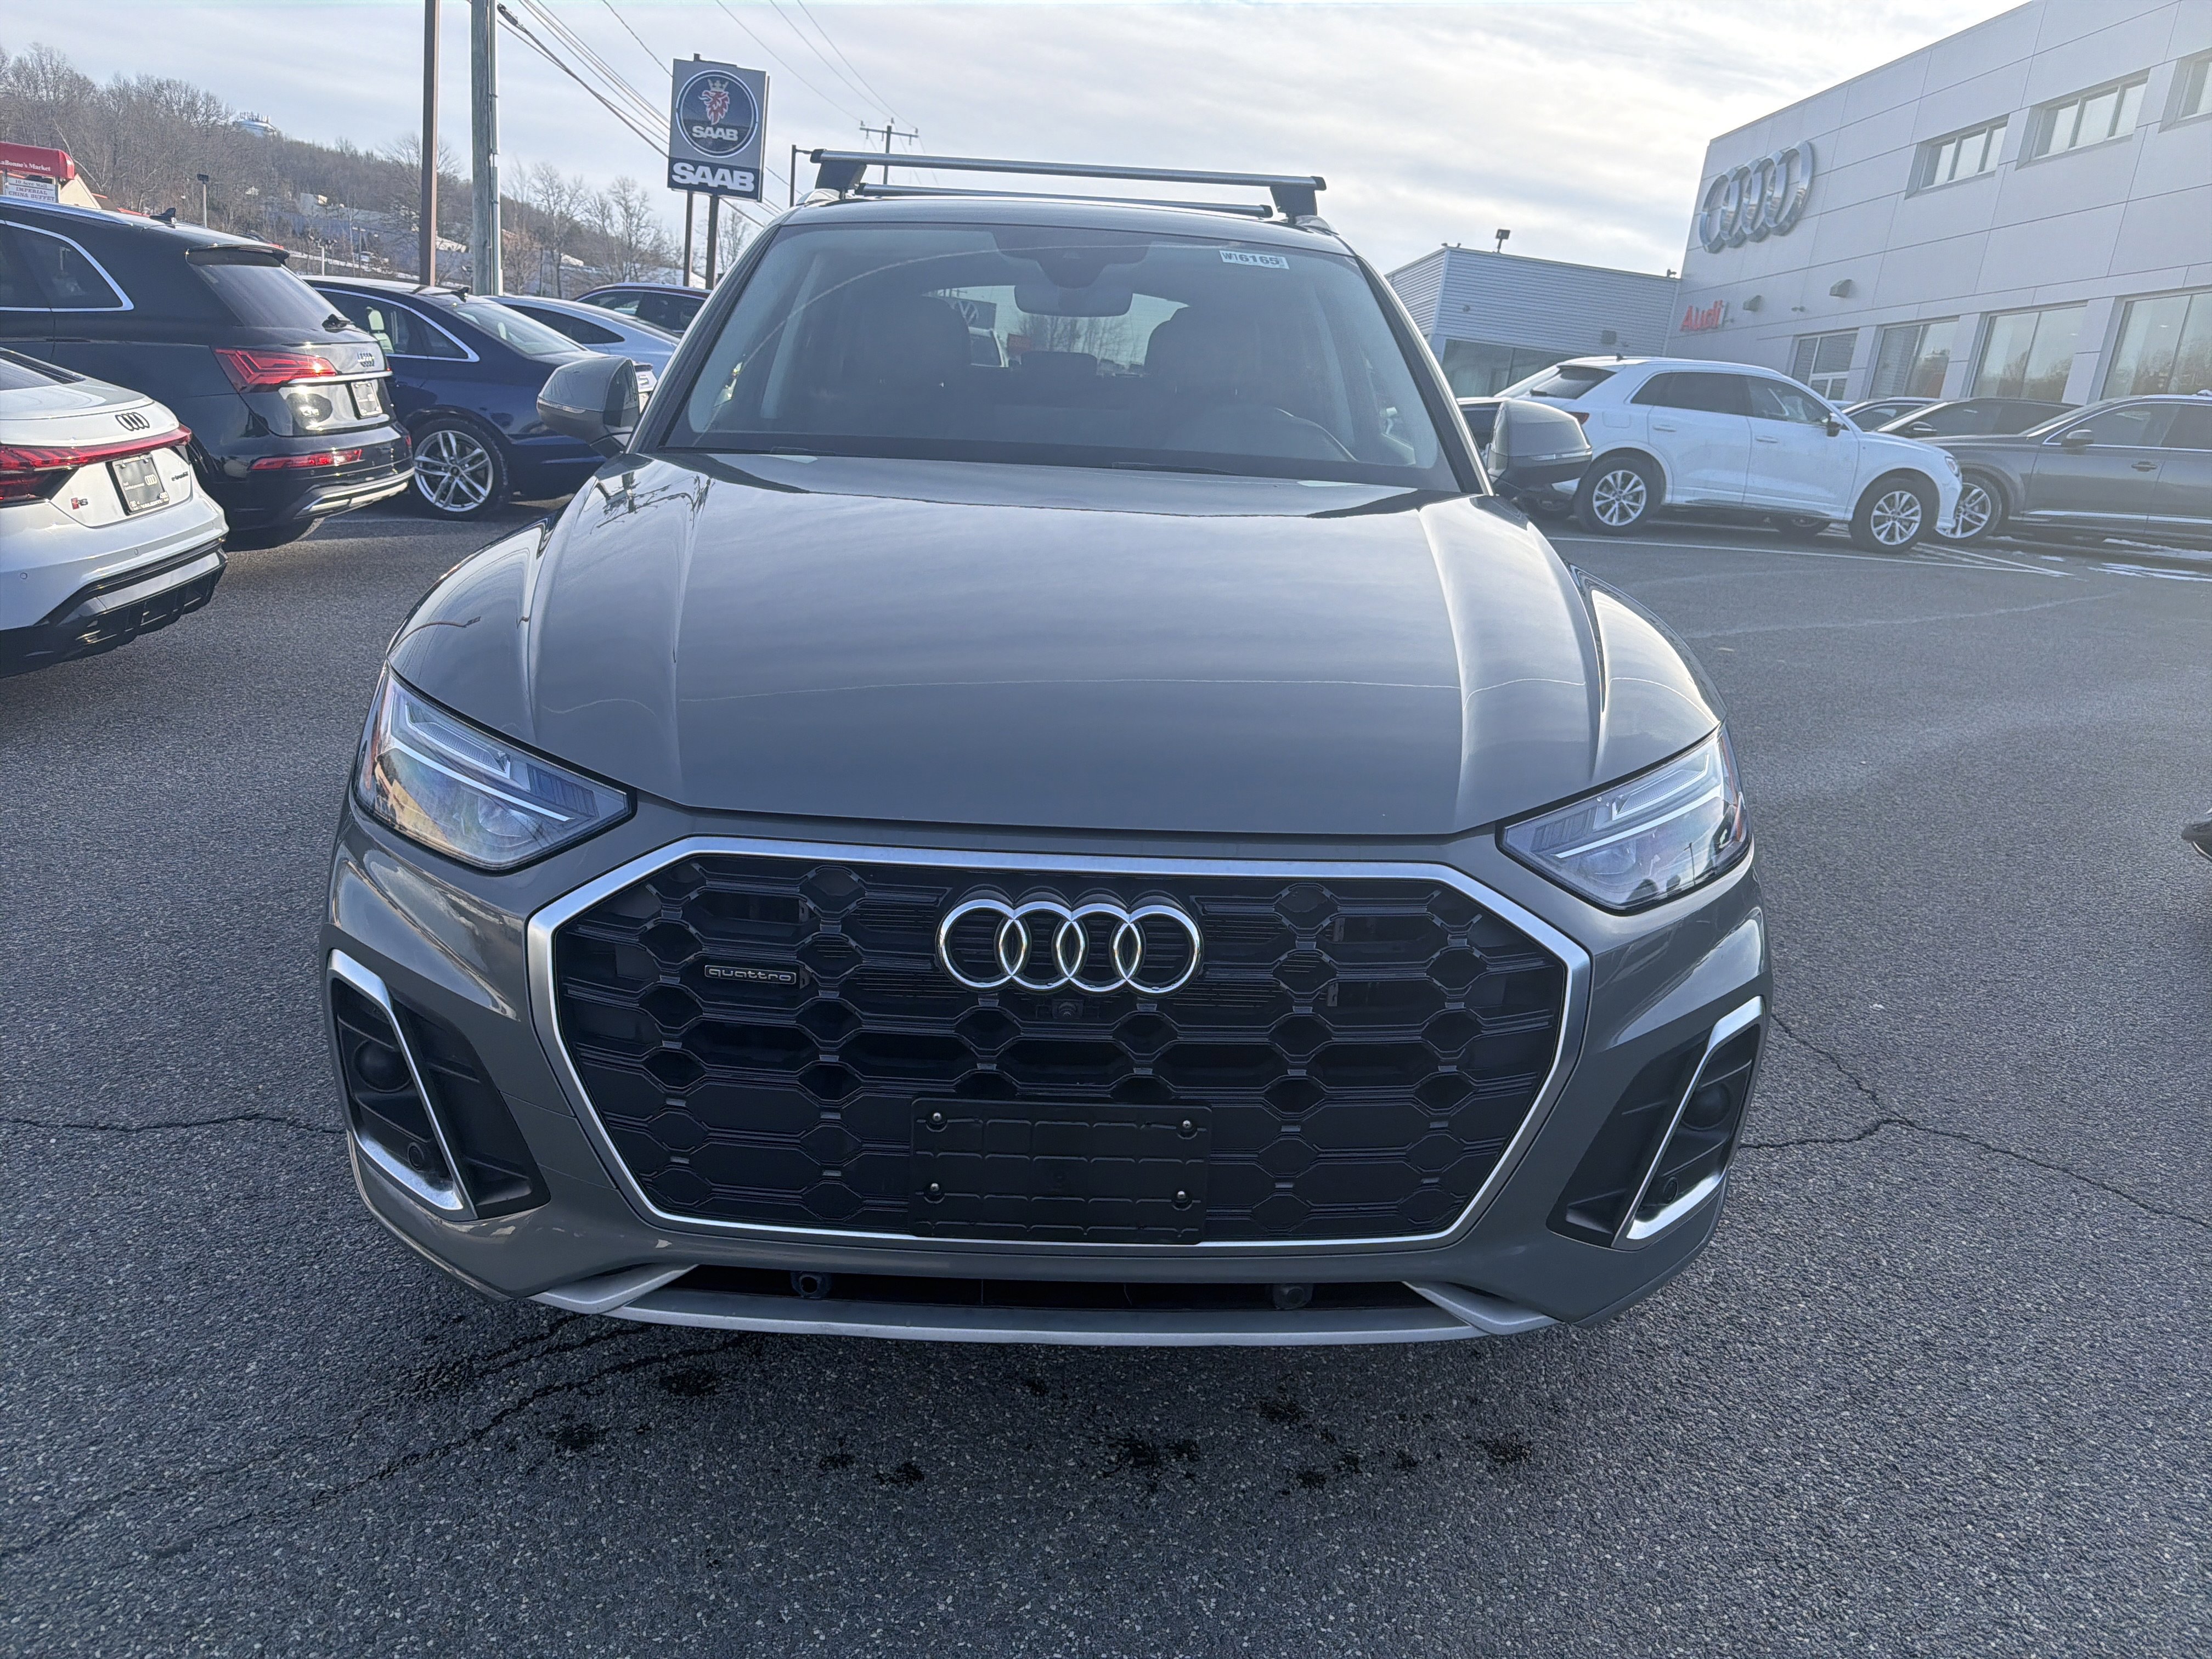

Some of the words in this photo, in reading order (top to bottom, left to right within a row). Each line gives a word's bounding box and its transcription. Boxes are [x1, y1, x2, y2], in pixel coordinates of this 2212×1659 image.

[692, 126, 738, 141] SAAB
[0, 160, 27, 168] aBonne's
[29, 163, 50, 171] Market
[672, 162, 755, 192] SAAB
[16, 187, 48, 195] IMPERIAL
[1679, 300, 1724, 332] Audi
[708, 968, 792, 981] quattro
